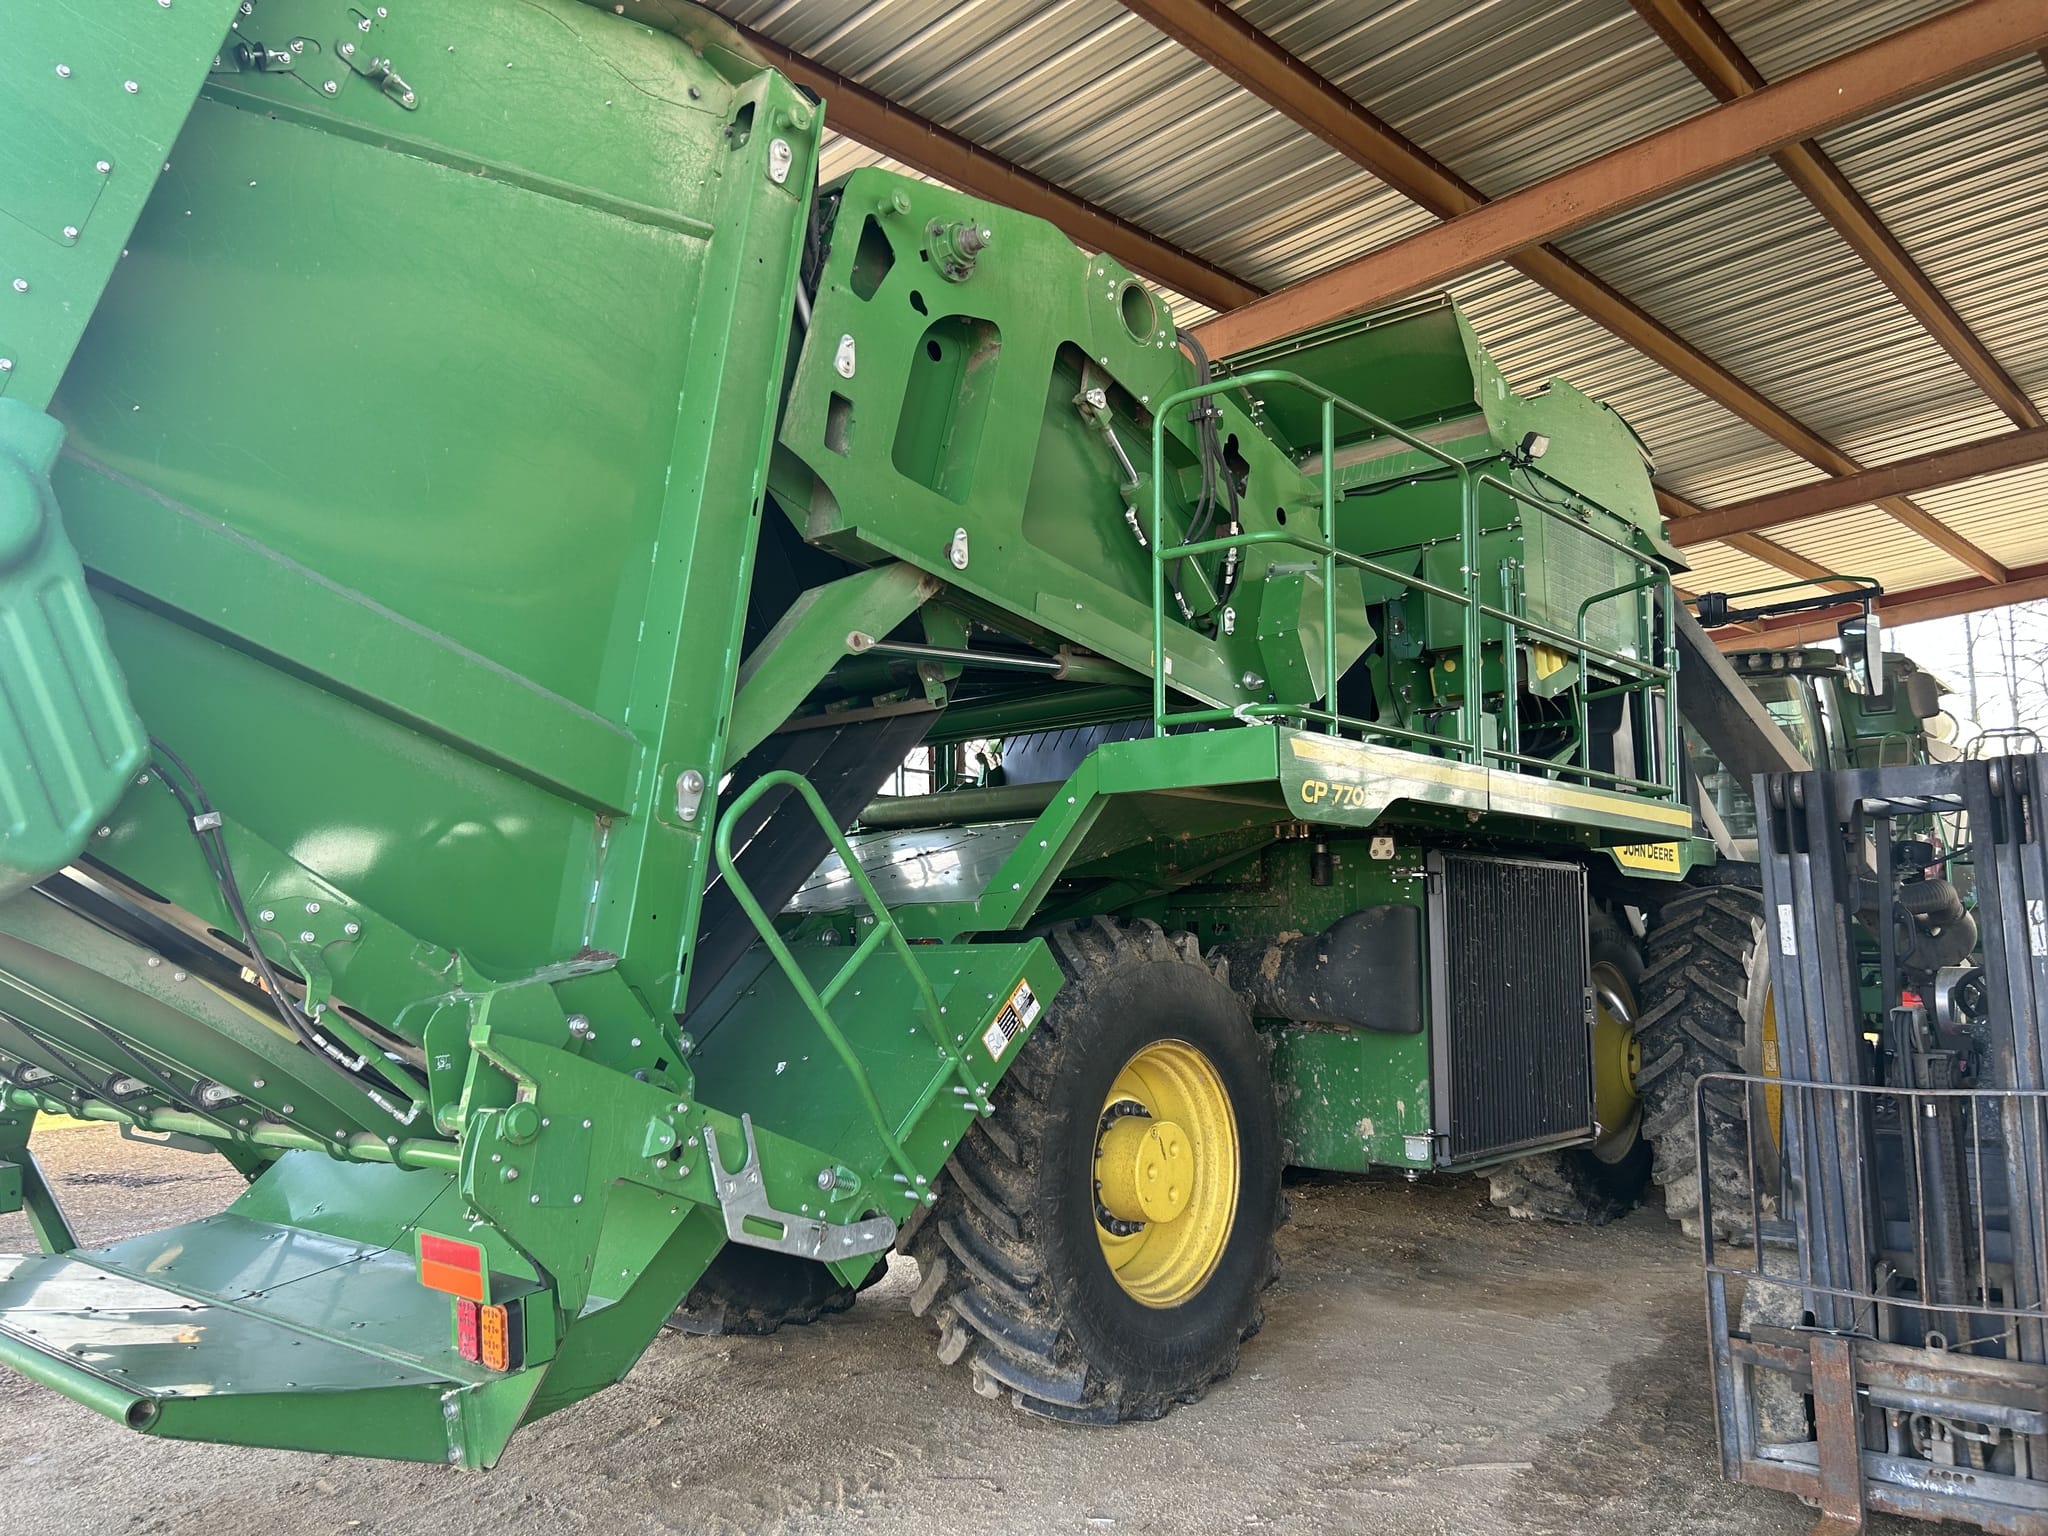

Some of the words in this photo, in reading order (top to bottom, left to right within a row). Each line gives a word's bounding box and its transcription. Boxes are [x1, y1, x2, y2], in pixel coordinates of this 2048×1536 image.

[1301, 779, 1328, 804] CP
[1331, 783, 1365, 807] 770
[1623, 843, 1646, 858] JOHN
[1647, 844, 1674, 862] DEERE
